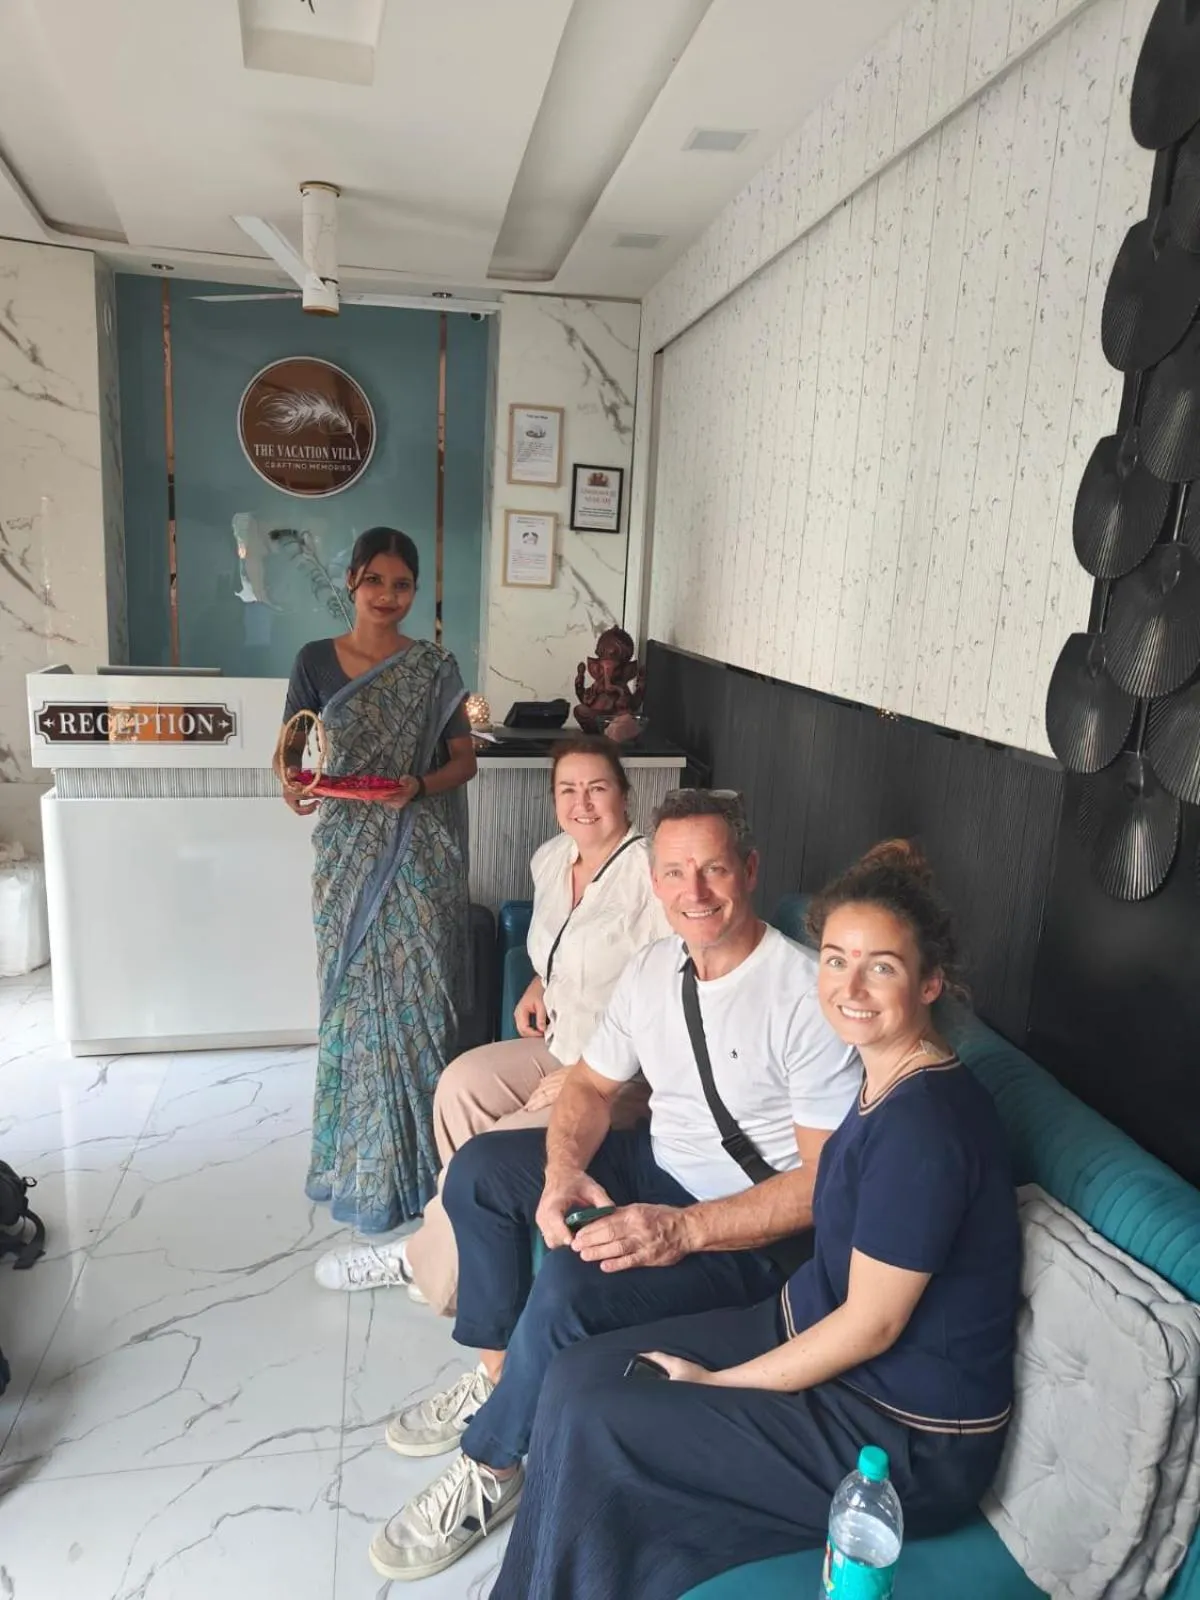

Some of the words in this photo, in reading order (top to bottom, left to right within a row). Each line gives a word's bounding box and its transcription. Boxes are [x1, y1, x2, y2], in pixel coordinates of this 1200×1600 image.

[254, 444, 274, 457] THE
[277, 445, 330, 459] VACATION
[331, 447, 361, 460] VILLA
[309, 463, 352, 471] MEMORIES
[59, 712, 215, 735] RECEPTION
